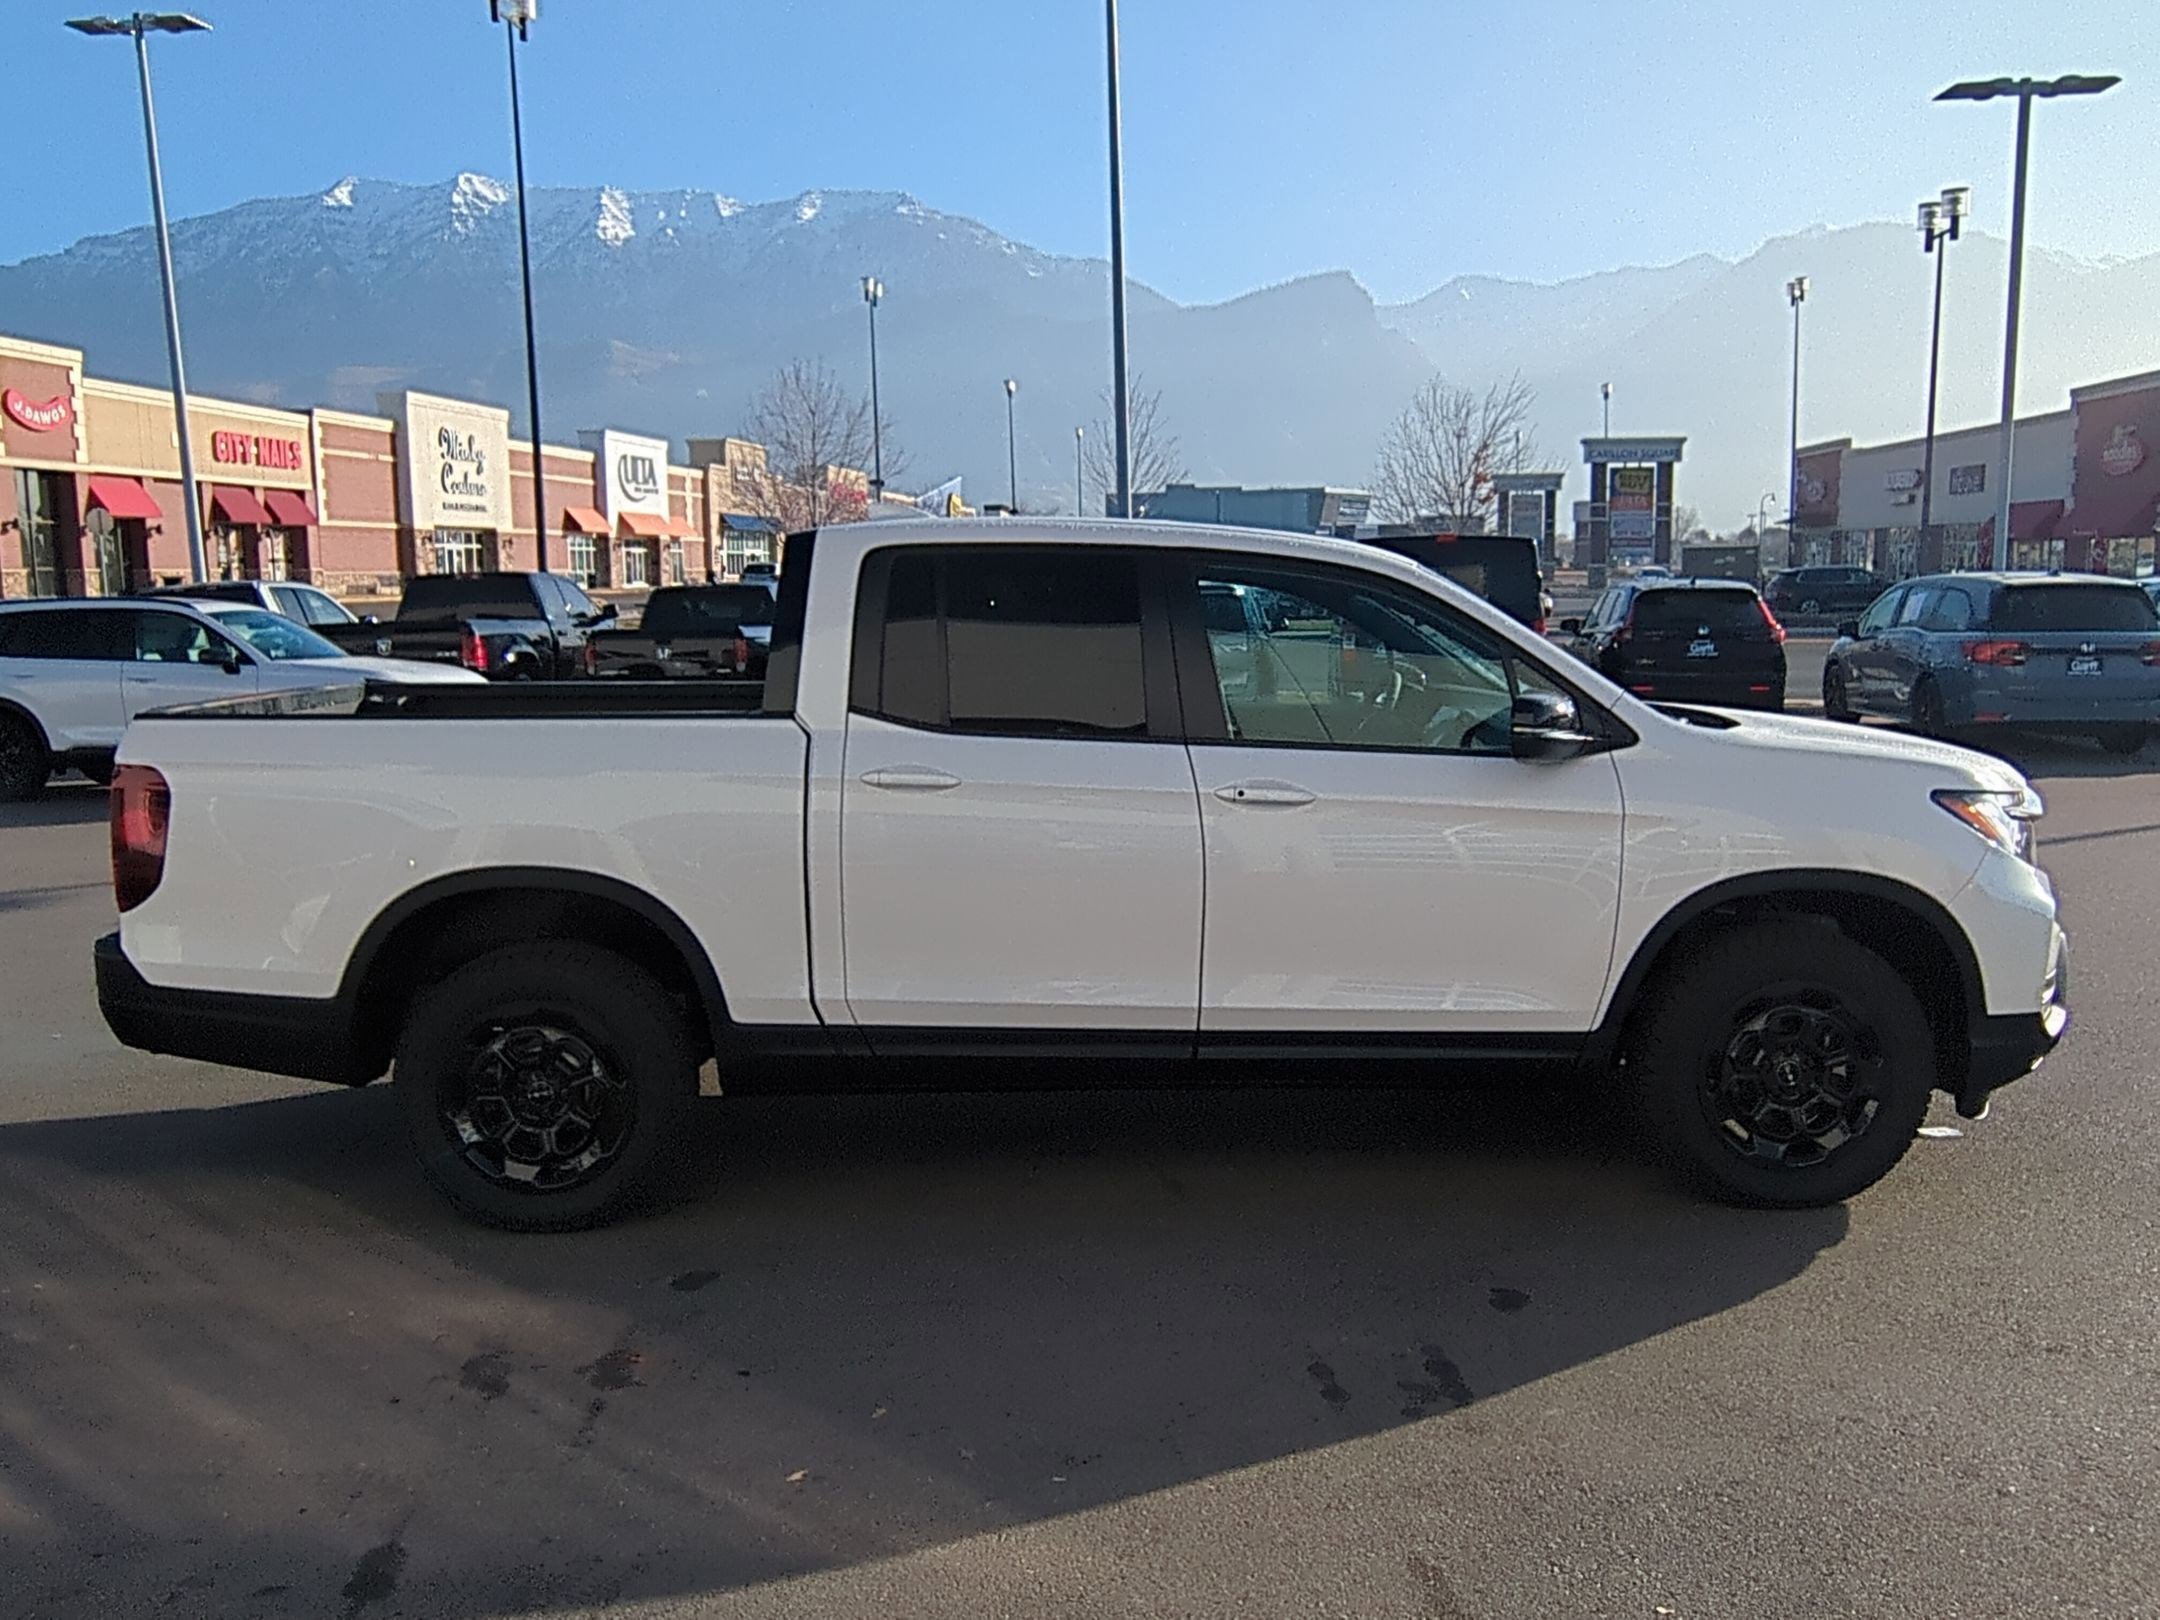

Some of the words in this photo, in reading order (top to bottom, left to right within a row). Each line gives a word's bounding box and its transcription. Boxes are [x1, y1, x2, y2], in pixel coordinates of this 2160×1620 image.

[212, 431, 252, 464] CITY
[255, 436, 302, 470] NAILS
[618, 454, 657, 488] ULTA
